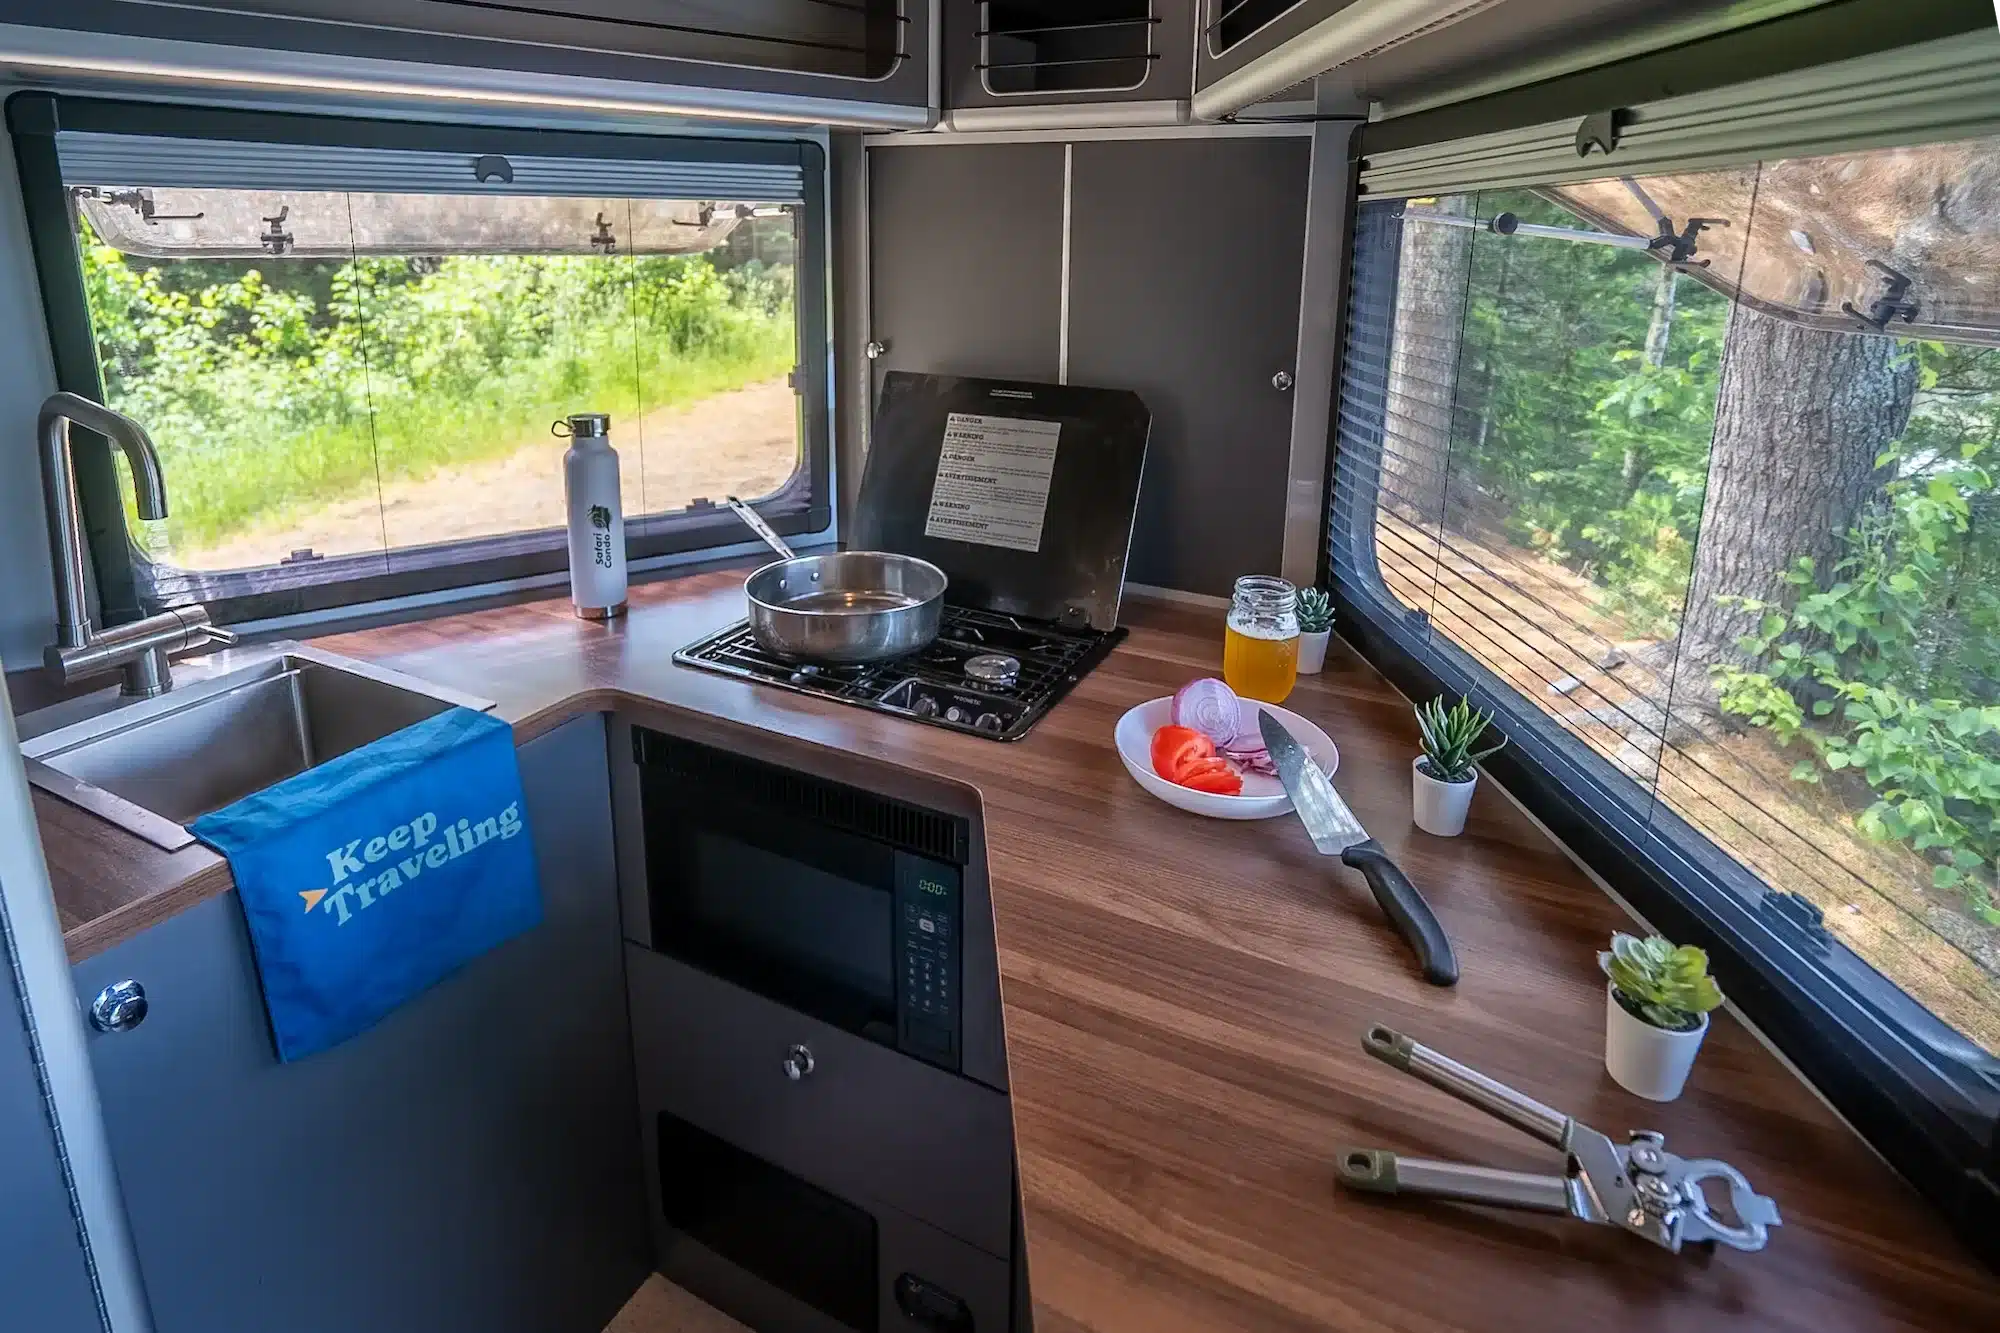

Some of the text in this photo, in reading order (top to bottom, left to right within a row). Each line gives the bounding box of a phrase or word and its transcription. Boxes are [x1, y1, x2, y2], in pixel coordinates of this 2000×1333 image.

[956, 416, 983, 425] DANGER
[952, 431, 985, 440] WARNING
[948, 454, 976, 462] DANGER
[939, 501, 971, 511] WARNING
[593, 532, 604, 565] Safari
[603, 534, 612, 569] Condo
[325, 811, 437, 886] Keep
[323, 800, 523, 927] Traveling
